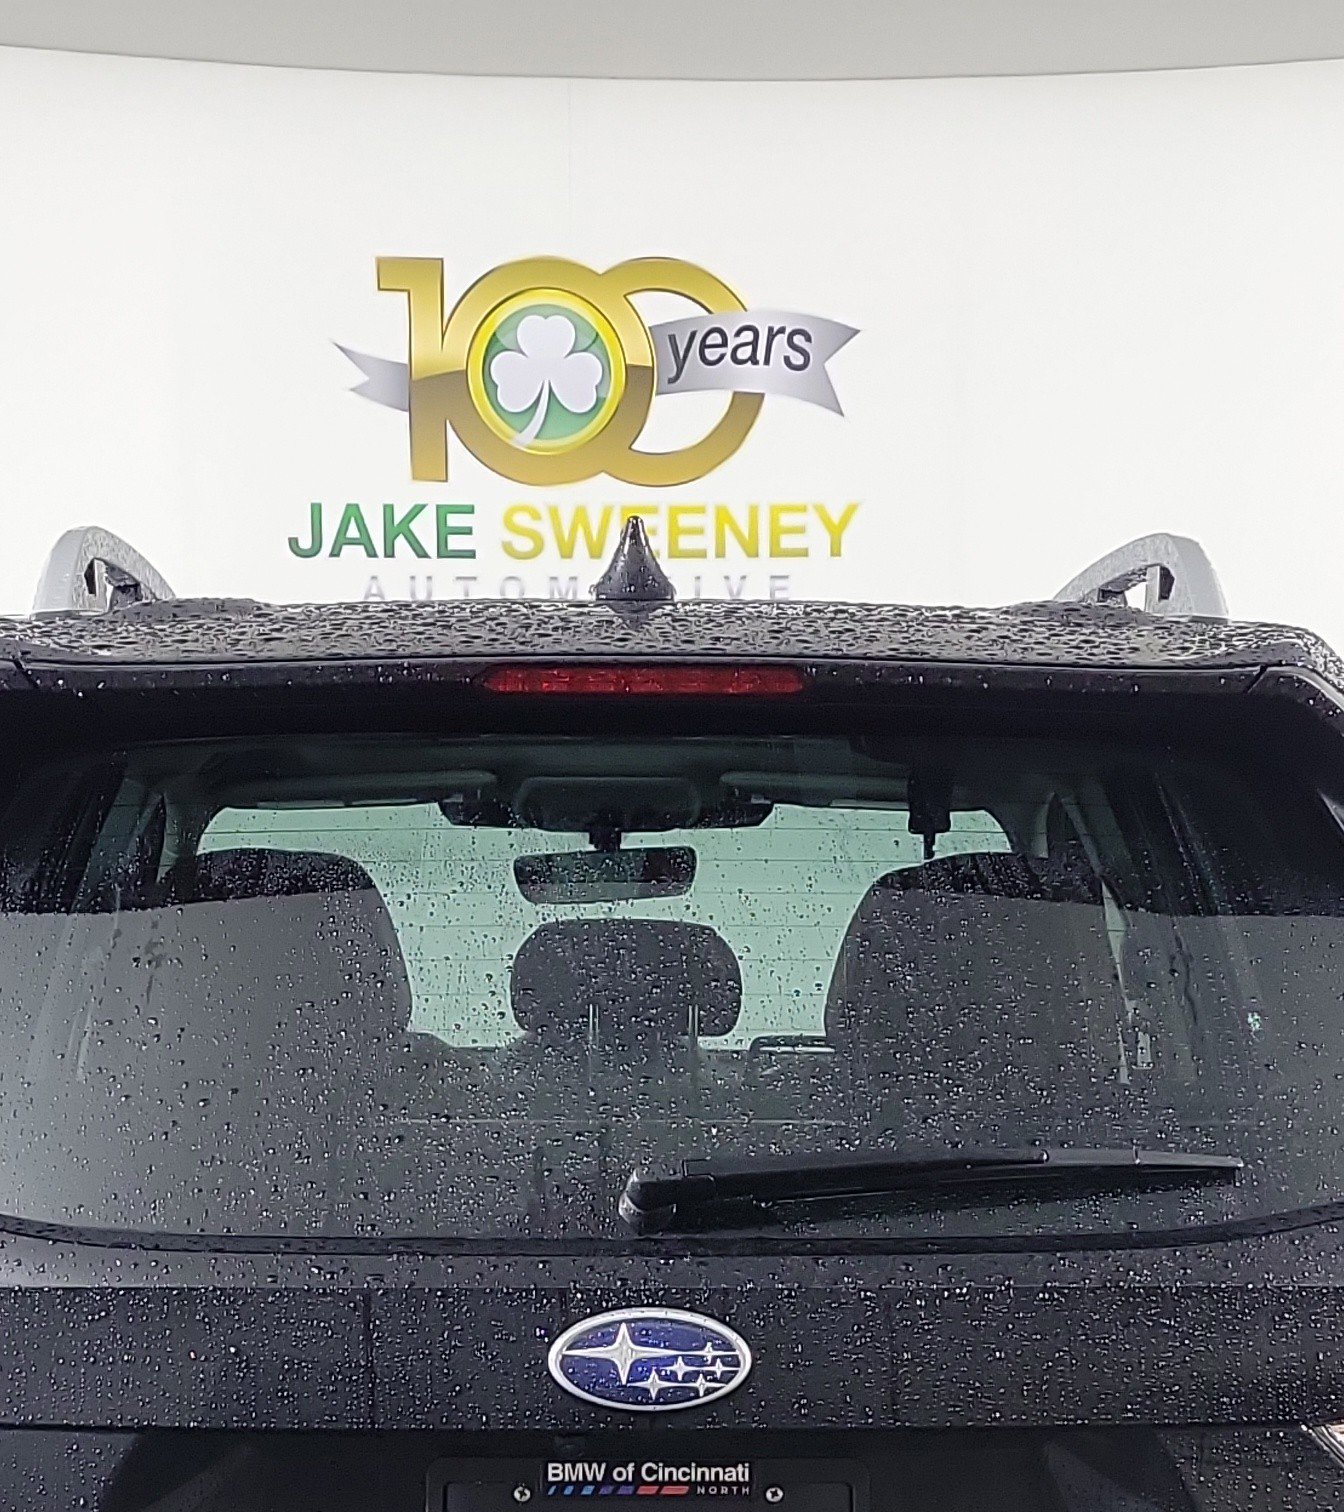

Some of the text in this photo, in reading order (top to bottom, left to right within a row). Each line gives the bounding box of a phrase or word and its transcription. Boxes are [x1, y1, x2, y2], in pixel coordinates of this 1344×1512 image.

[375, 255, 765, 487] 100
[666, 322, 814, 384] years
[287, 502, 477, 560] JAKE
[363, 574, 791, 600] AUTOMIVE
[546, 1462, 750, 1482] BMW of Cincinnati
[696, 1485, 751, 1495] NORTH
